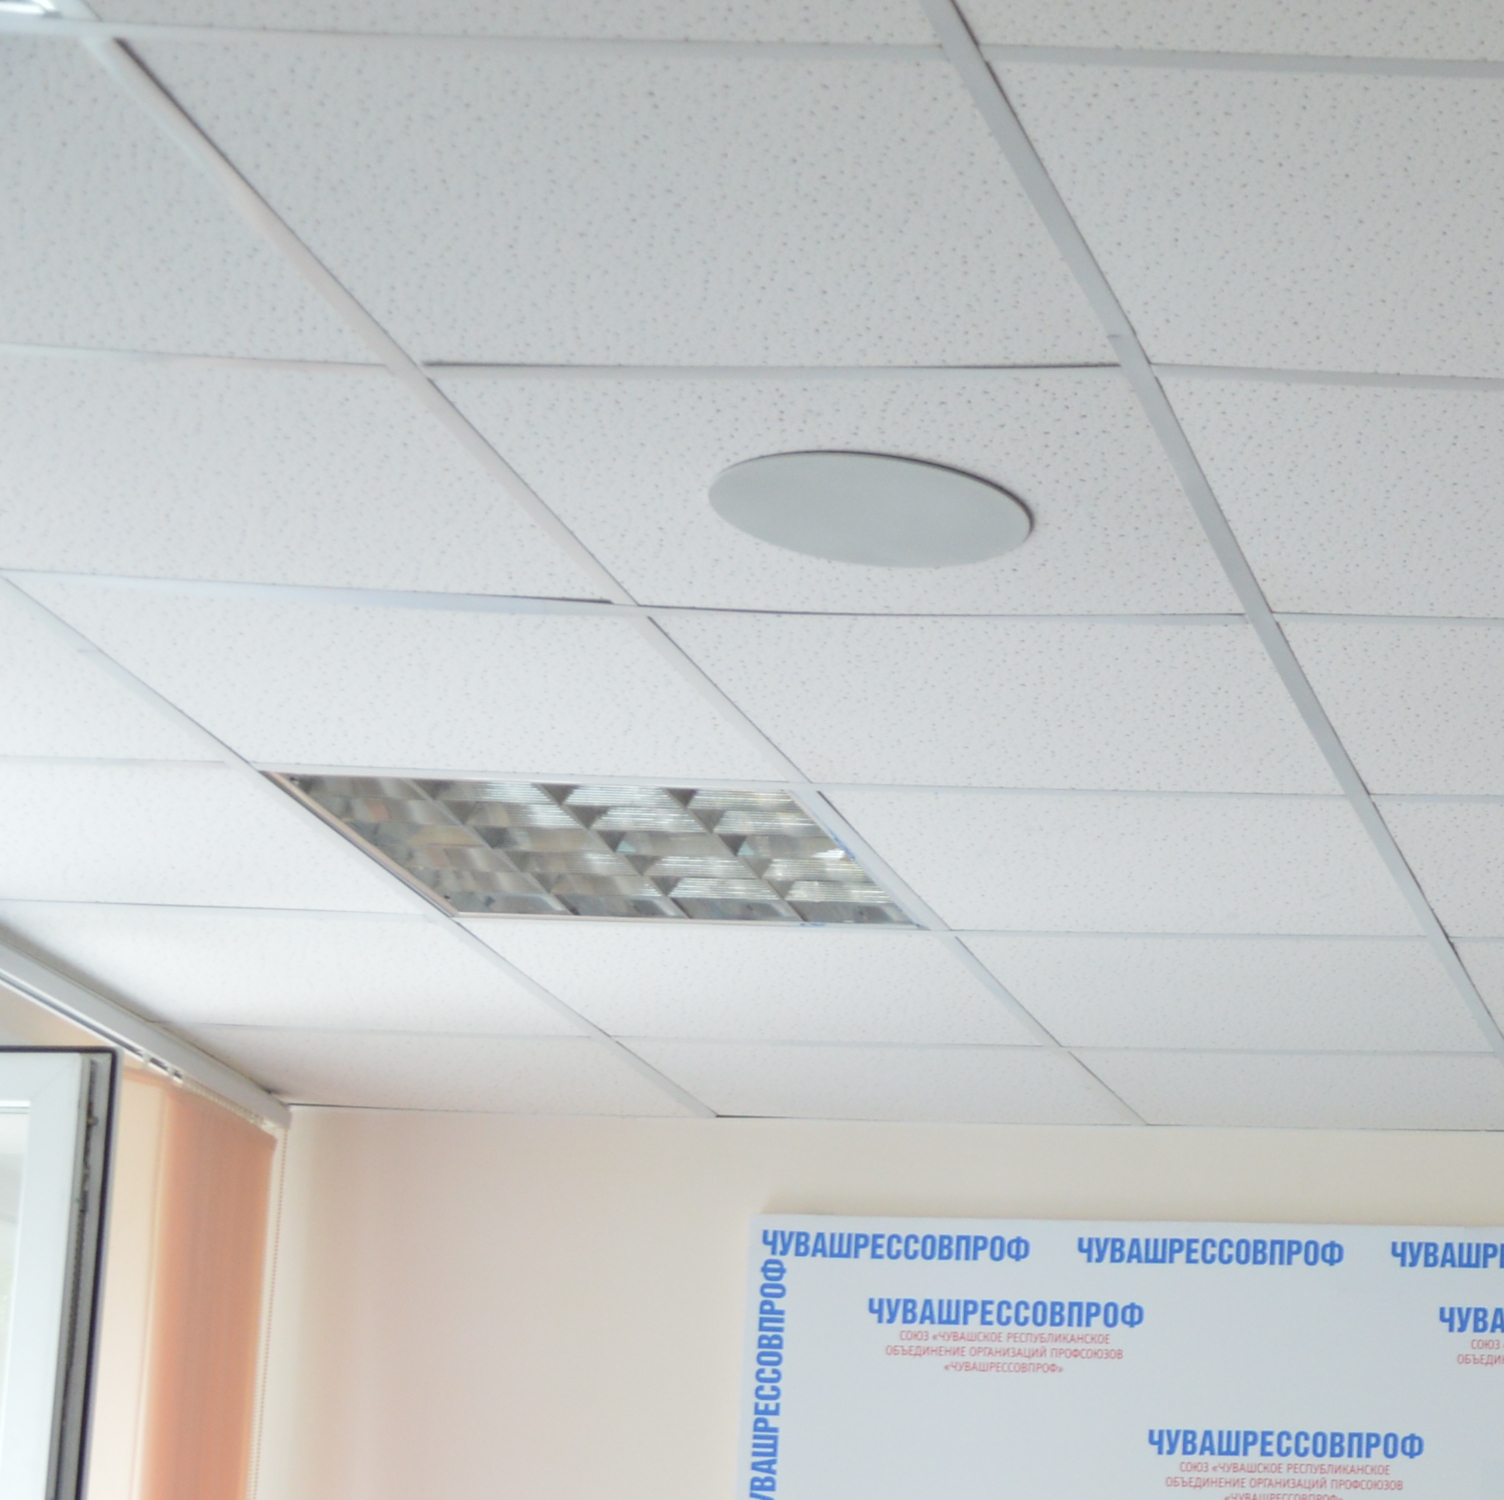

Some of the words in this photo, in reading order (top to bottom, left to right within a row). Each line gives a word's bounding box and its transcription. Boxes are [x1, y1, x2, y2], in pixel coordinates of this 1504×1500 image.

[762, 1229, 1030, 1263] ЧУВАШРЕССОВПРОФ
[1078, 1237, 1344, 1266] ЧУВАШРЕССОВПРОФ
[868, 1298, 1144, 1328] ЧУВАШРЕССОВПРОФ
[899, 1330, 930, 1342] СОЮЗ
[932, 1331, 1004, 1343] «ЧУВАШСКОЕ
[1007, 1332, 1111, 1345] РЕСПУБЛИКАНСКОЕ
[1470, 1338, 1501, 1350] СОЮЗ
[885, 1344, 965, 1358] ОБЪЕДИНЕНИЕ
[969, 1345, 1047, 1359] ОРГАНИЗАЦИЙ
[1051, 1346, 1125, 1360] ПРОФСОЮЗОВ
[944, 1362, 1064, 1372] «ЧУВАШРЕССОВПРОФ»
[1148, 1429, 1424, 1459] ЧУВАШРЕССОВПРОФ
[1179, 1461, 1210, 1473] СОЮЗ
[1212, 1461, 1284, 1474] «ЧУВАШСКОЕ
[1287, 1462, 1392, 1475] РЕСПУБЛИКАНСКОЕ
[1166, 1475, 1246, 1489] ОБЪЕДИНЕНИЕ
[1250, 1477, 1328, 1491] ОРГАНИЗАЦИЙ
[1331, 1478, 1405, 1492] ПРОФСОЮЗОВ
